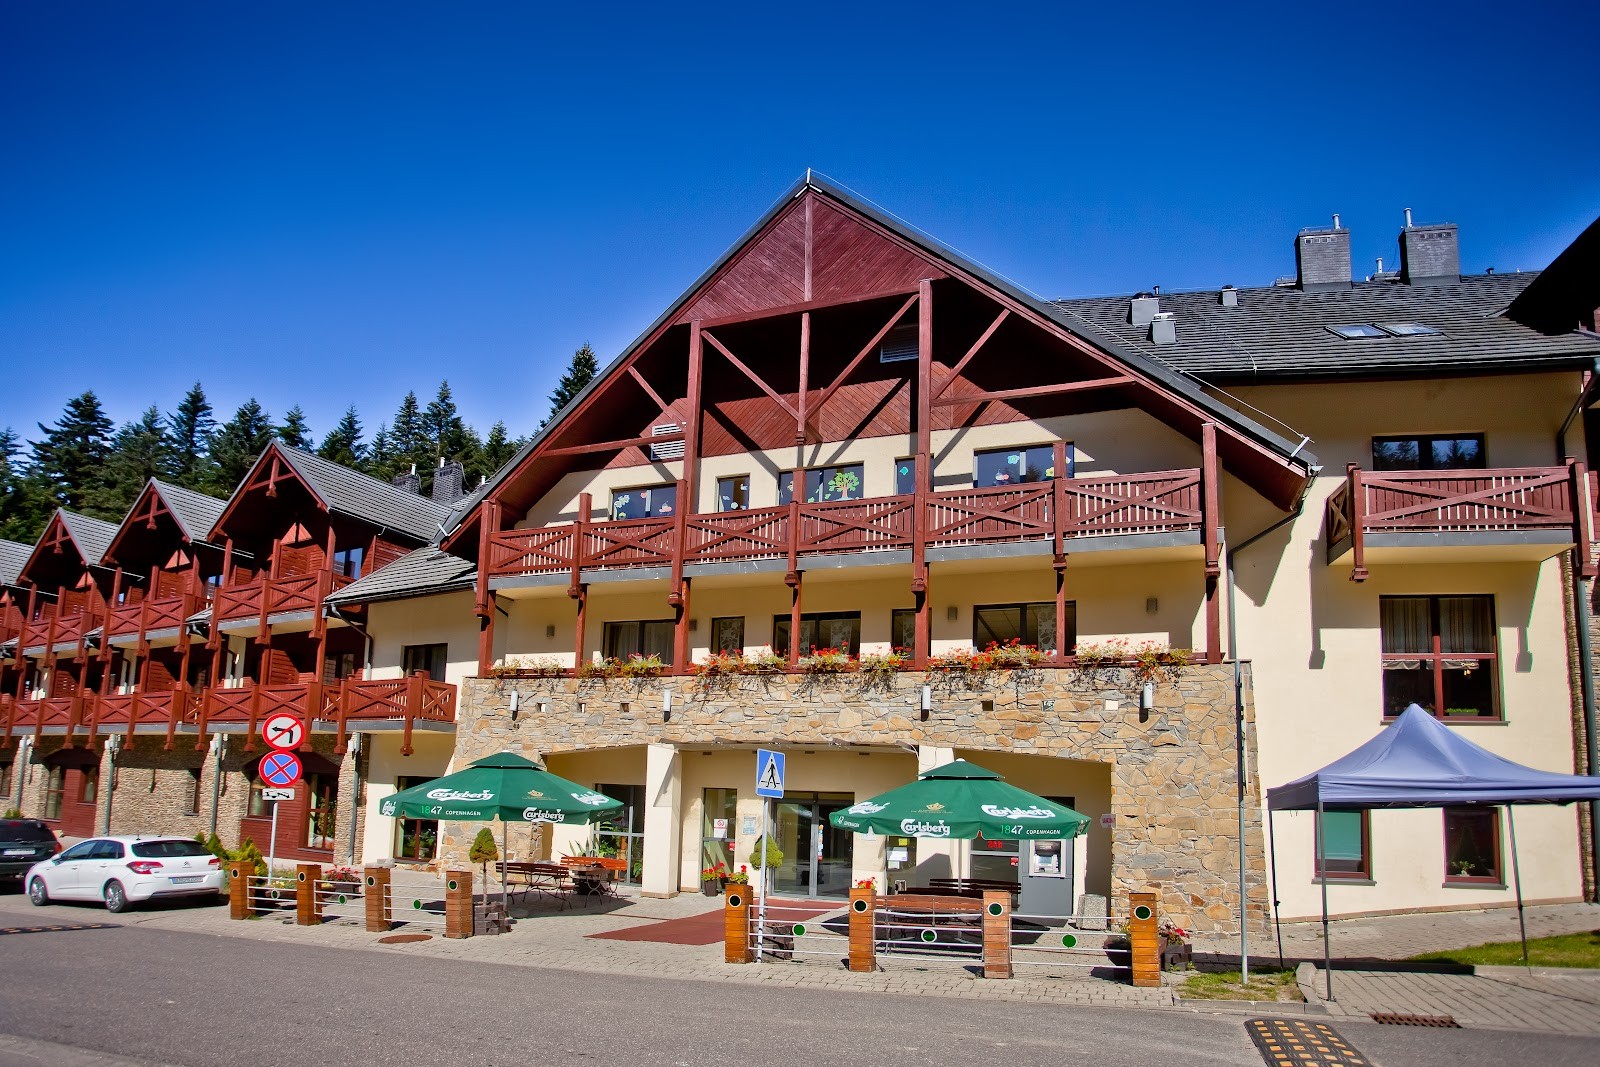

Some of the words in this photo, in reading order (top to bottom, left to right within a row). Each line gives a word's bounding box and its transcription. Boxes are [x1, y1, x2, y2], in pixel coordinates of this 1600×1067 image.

[426, 788, 495, 802] Carlsberg
[421, 805, 442, 815] 1847
[523, 807, 565, 823] Carlsberg
[981, 804, 1056, 819] Carlsberg
[900, 818, 950, 837] Carlsberg
[1001, 825, 1023, 835] 1847
